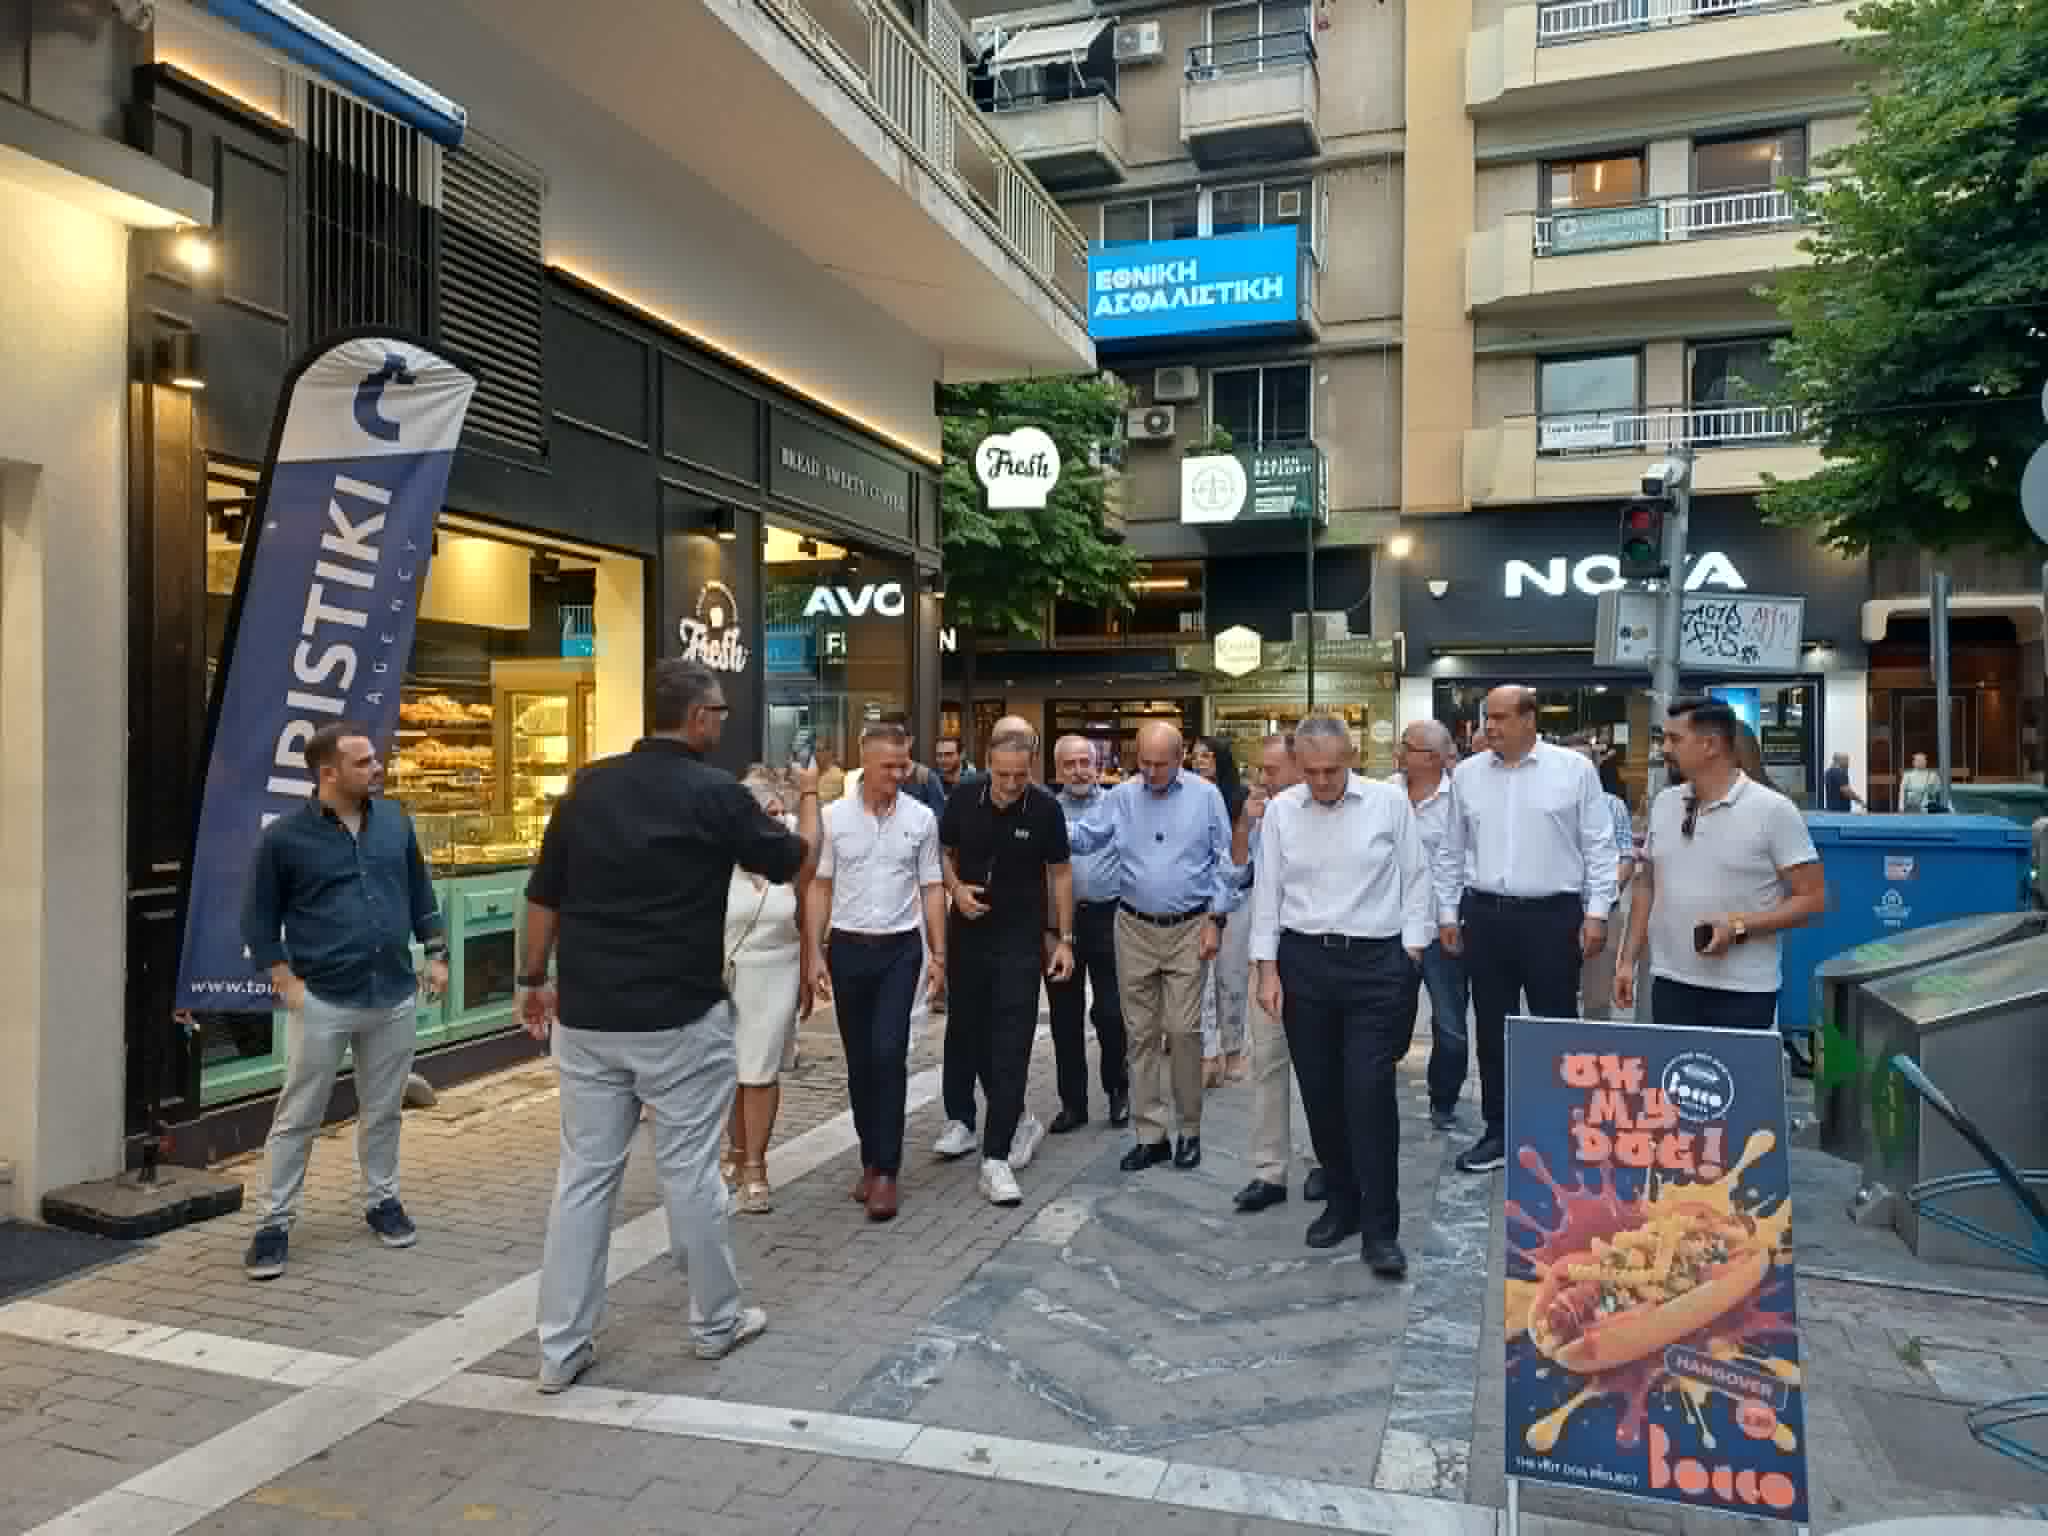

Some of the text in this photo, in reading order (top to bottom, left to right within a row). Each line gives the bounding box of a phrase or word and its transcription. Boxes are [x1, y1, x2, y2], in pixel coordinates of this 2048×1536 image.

[1095, 259, 1197, 292] ΕΘΝΙΚΗ
[1094, 276, 1283, 316] ΑΣΦΑΛΙΣΤΙΚΗ
[985, 447, 1054, 480] Fresh
[1505, 551, 1748, 597] NOA
[191, 977, 283, 993] www.tou
[1586, 1087, 1680, 1129] MY
[1675, 1352, 1778, 1402] HANGOVER
